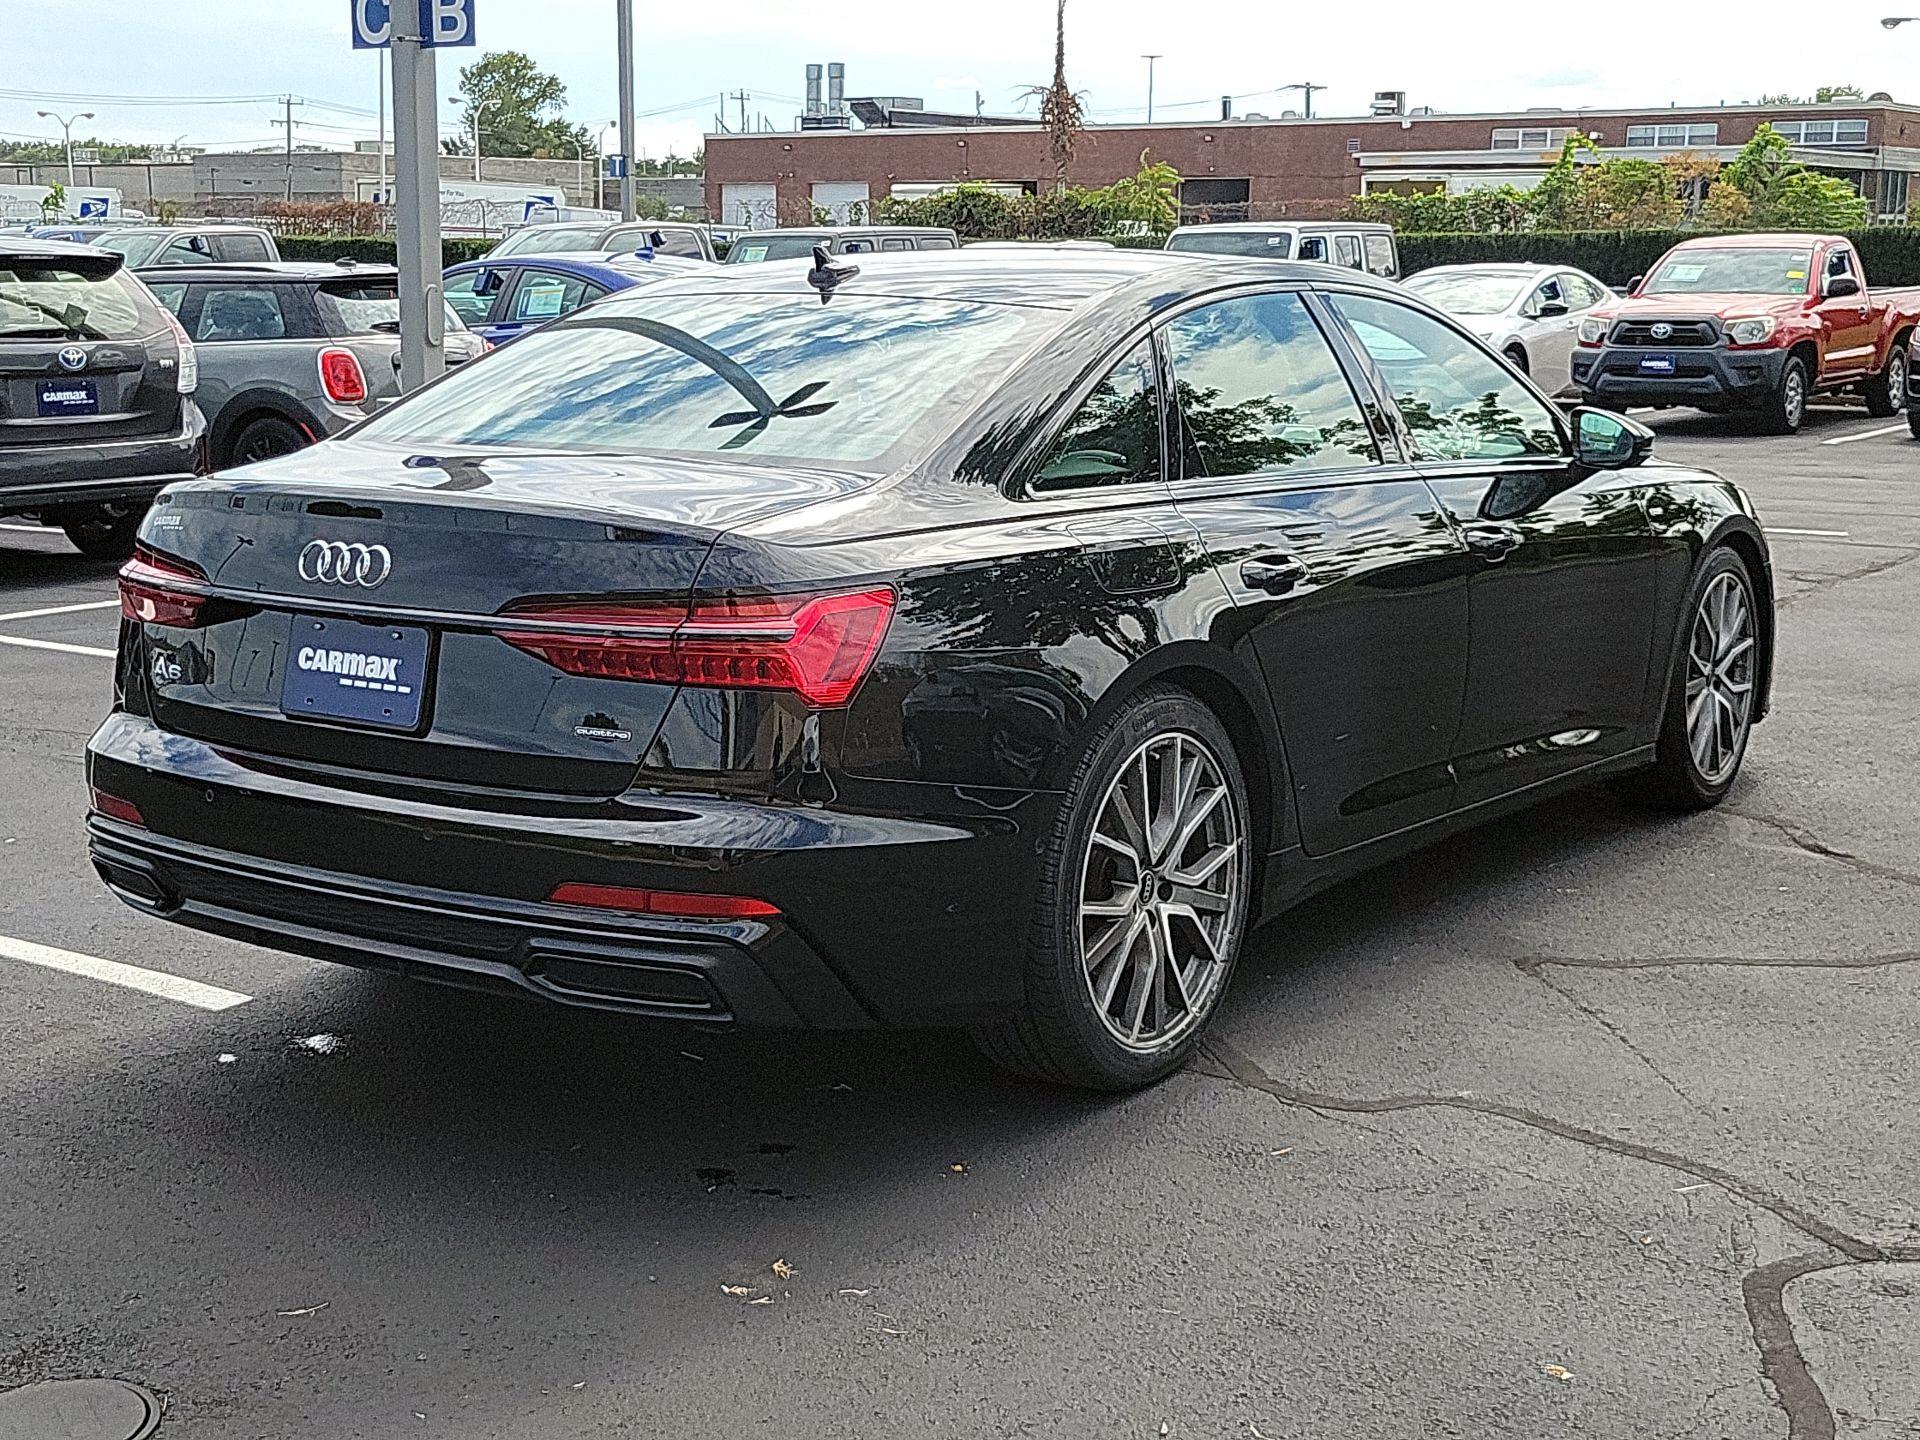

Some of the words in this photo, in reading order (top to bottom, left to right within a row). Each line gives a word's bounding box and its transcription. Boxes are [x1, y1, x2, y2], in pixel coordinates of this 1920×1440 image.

[356, 0, 391, 45] C
[432, 0, 468, 43] B
[611, 155, 624, 176] T
[154, 656, 182, 680] A6
[576, 728, 628, 739] quattro
